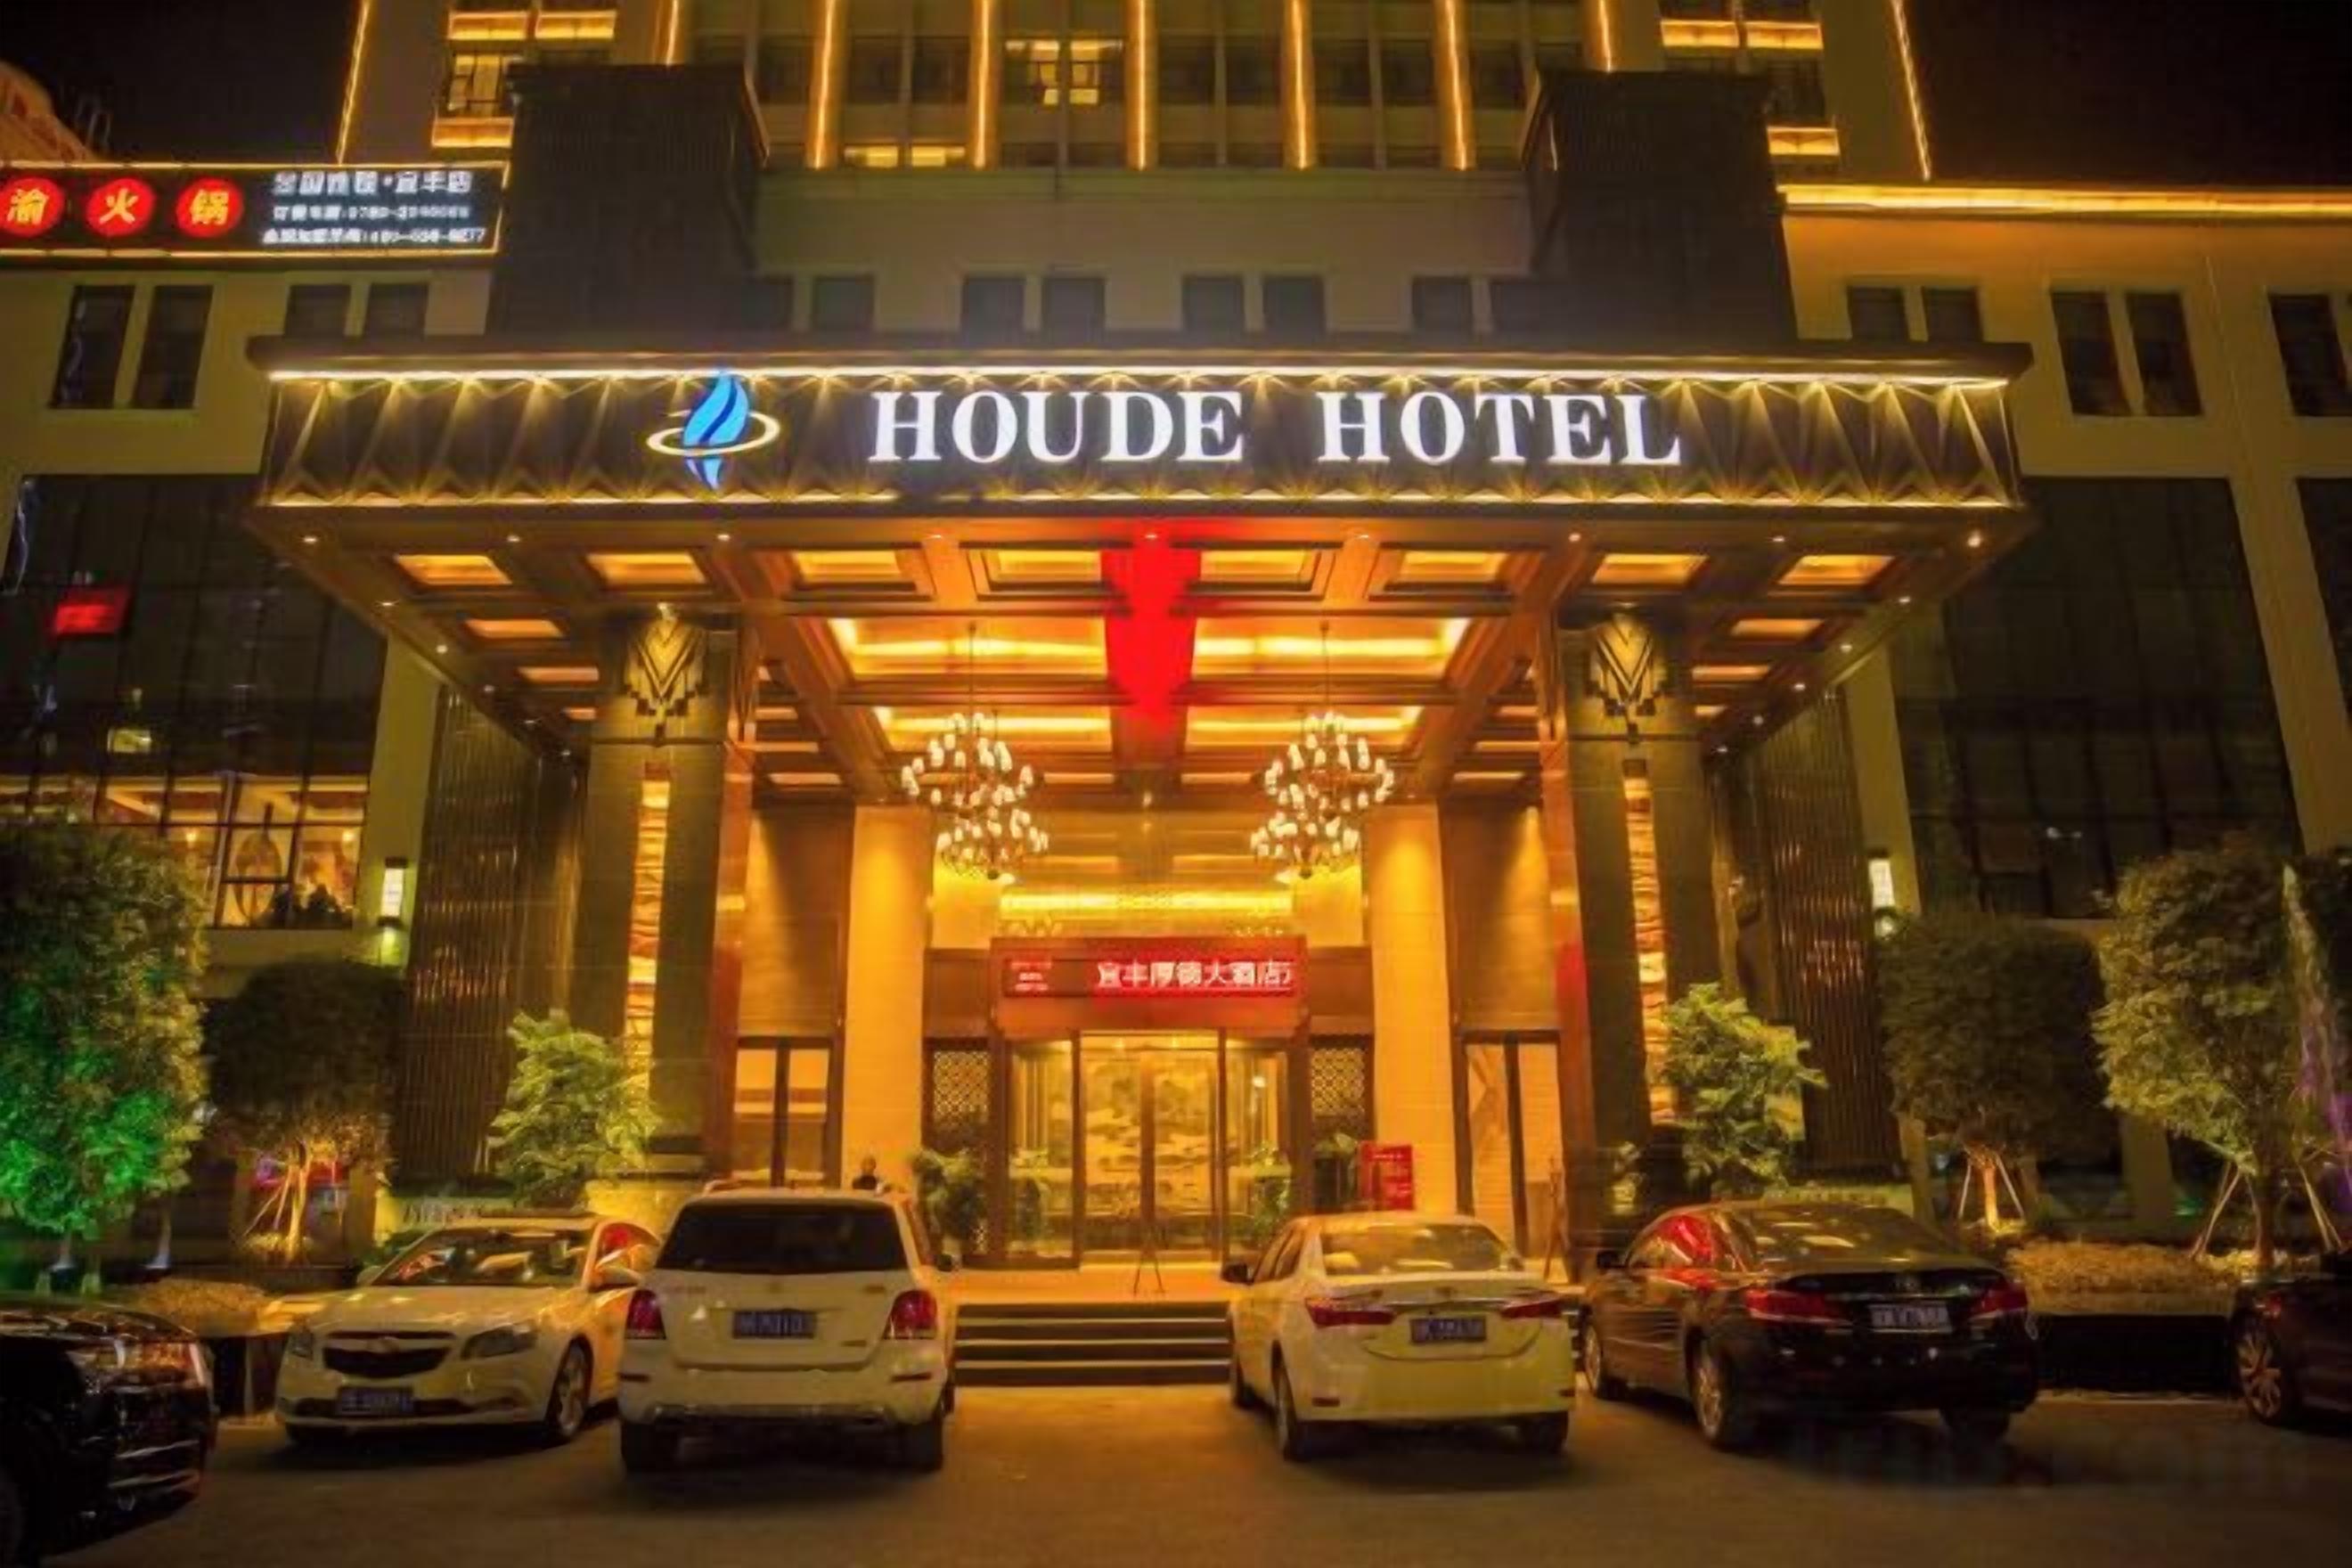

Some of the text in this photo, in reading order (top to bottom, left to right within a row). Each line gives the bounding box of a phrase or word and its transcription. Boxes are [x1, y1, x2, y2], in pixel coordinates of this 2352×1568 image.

[868, 389, 1682, 466] HOUDE HOTEL
[1097, 960, 1292, 988] 宜丰厚德大酒店
